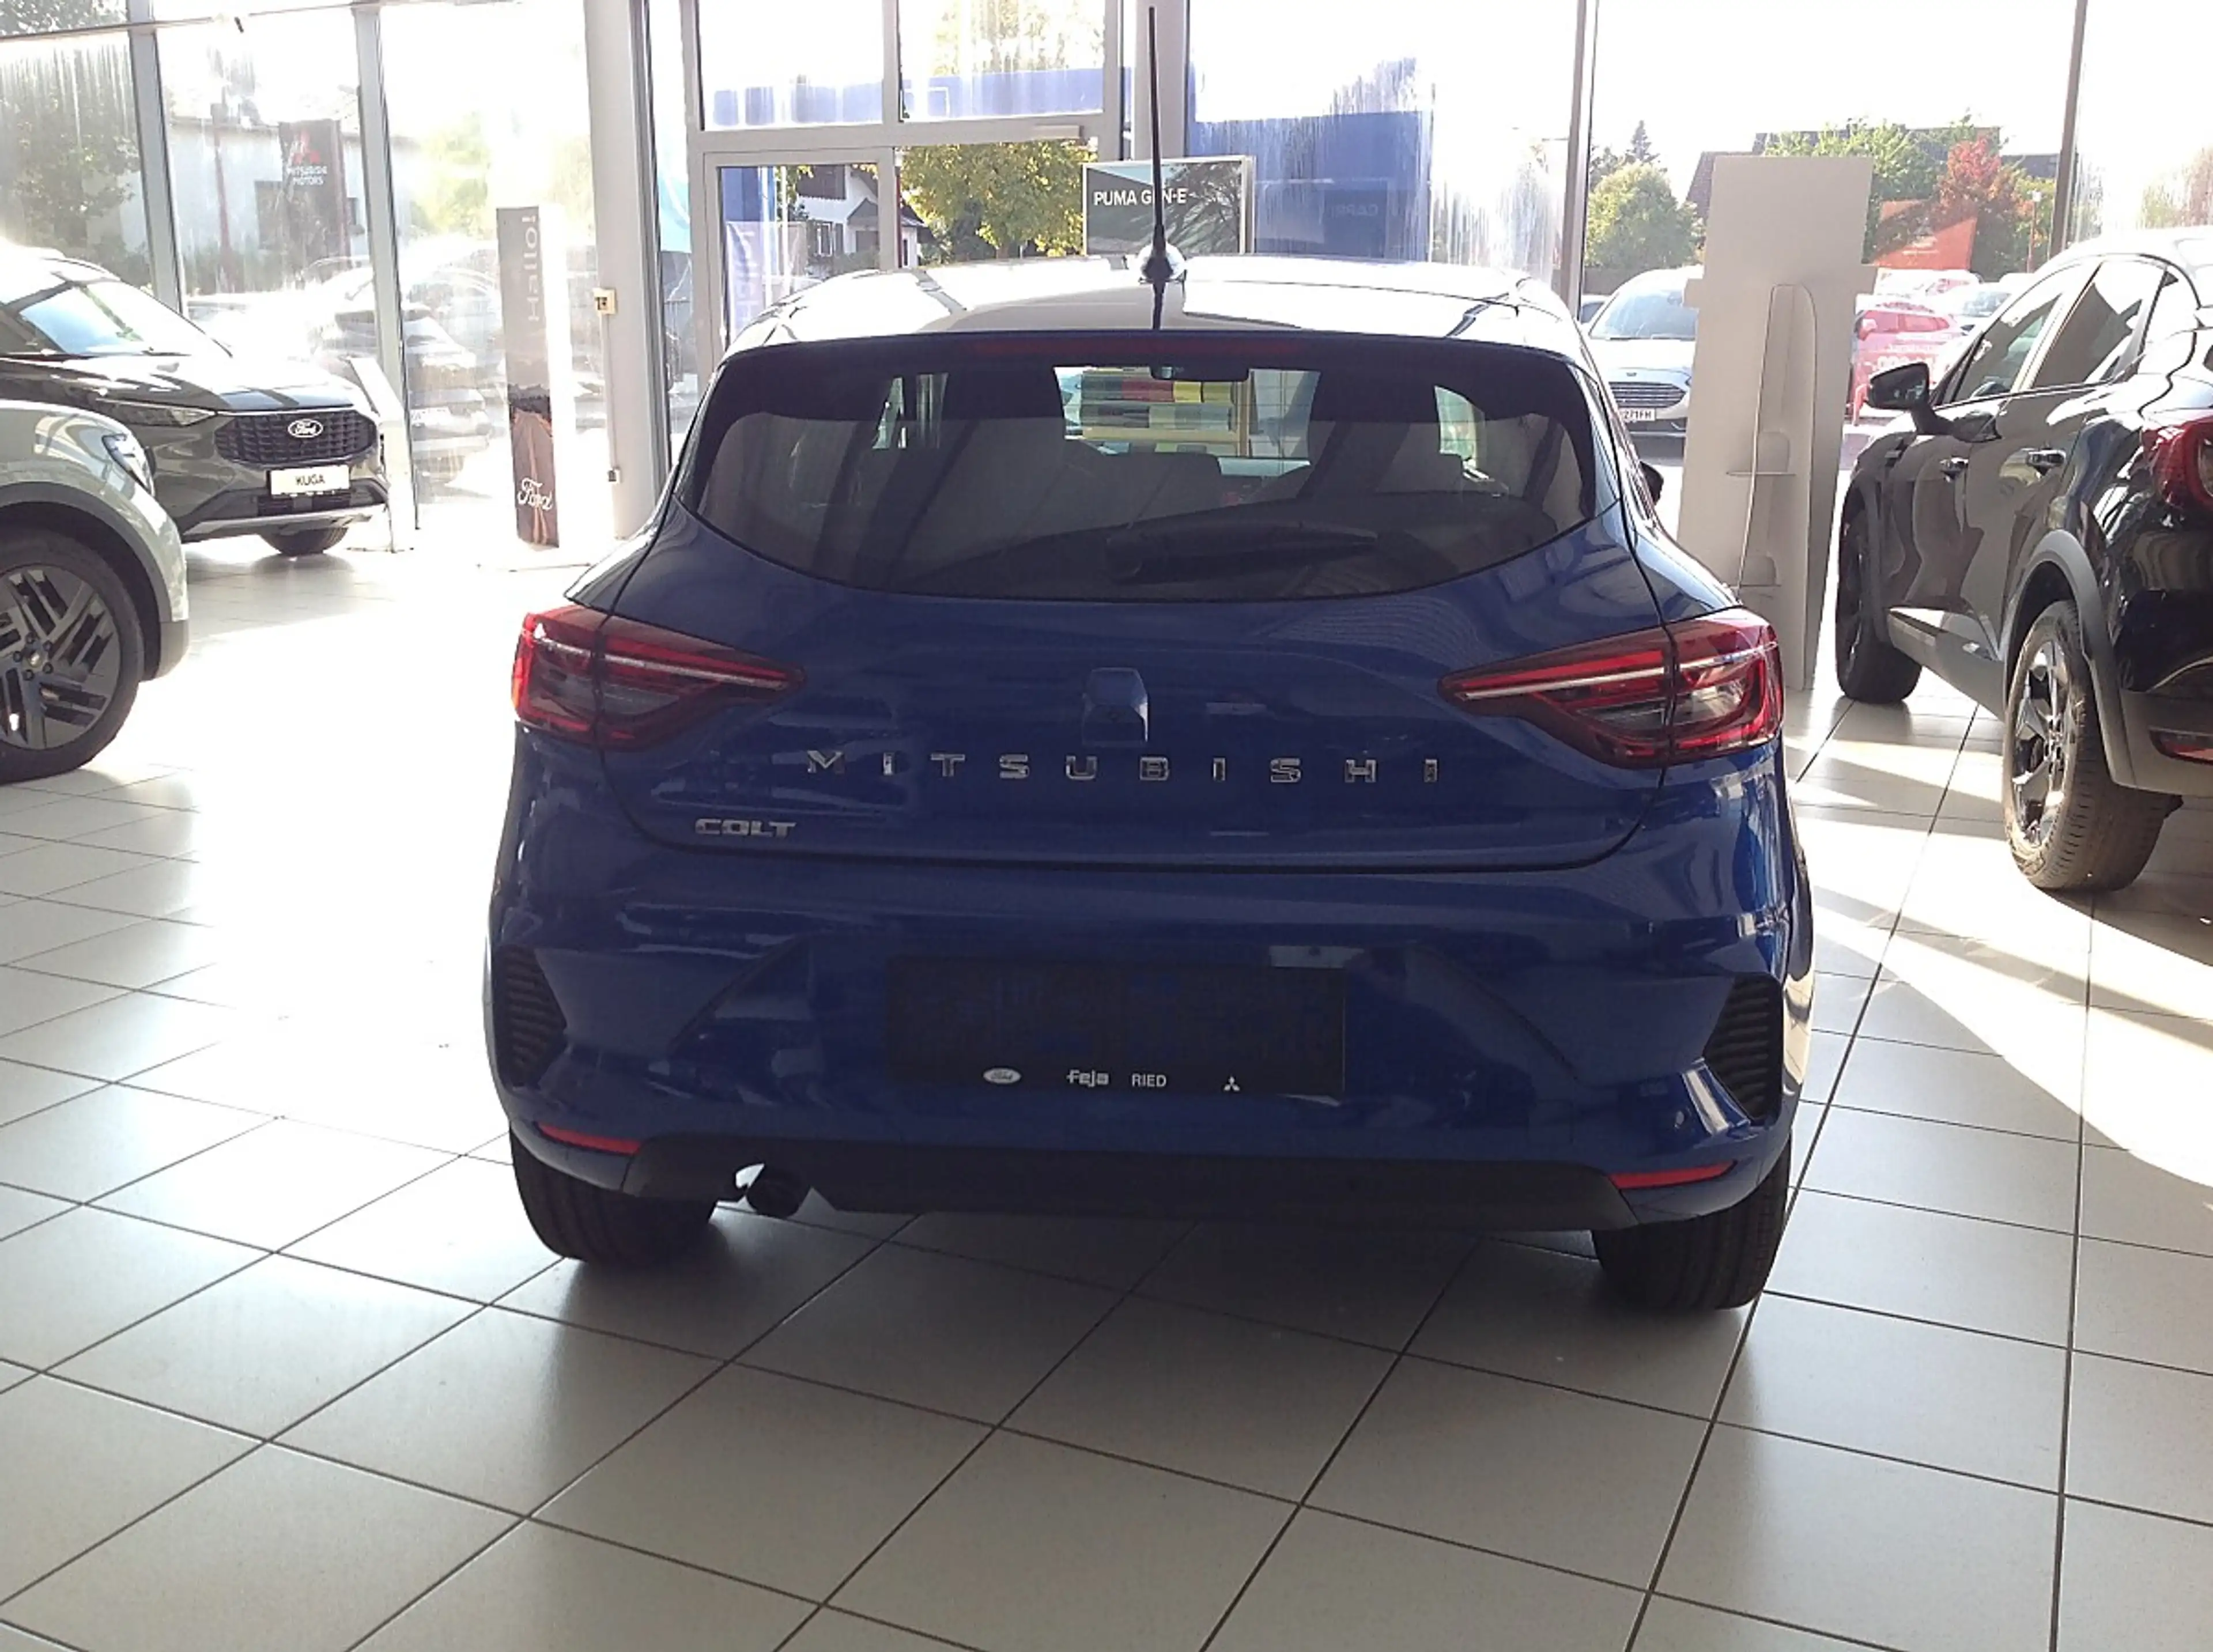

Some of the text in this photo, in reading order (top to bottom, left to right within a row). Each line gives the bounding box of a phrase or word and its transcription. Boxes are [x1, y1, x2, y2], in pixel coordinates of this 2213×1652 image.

[1094, 188, 1188, 205] PUMA GN-E
[522, 215, 540, 322] Hallo!
[296, 474, 326, 485] KUGA
[517, 477, 552, 510] Ford
[807, 750, 1438, 782] MITSUBISHI
[694, 818, 796, 838] COLT
[1132, 1074, 1166, 1087] RIED
